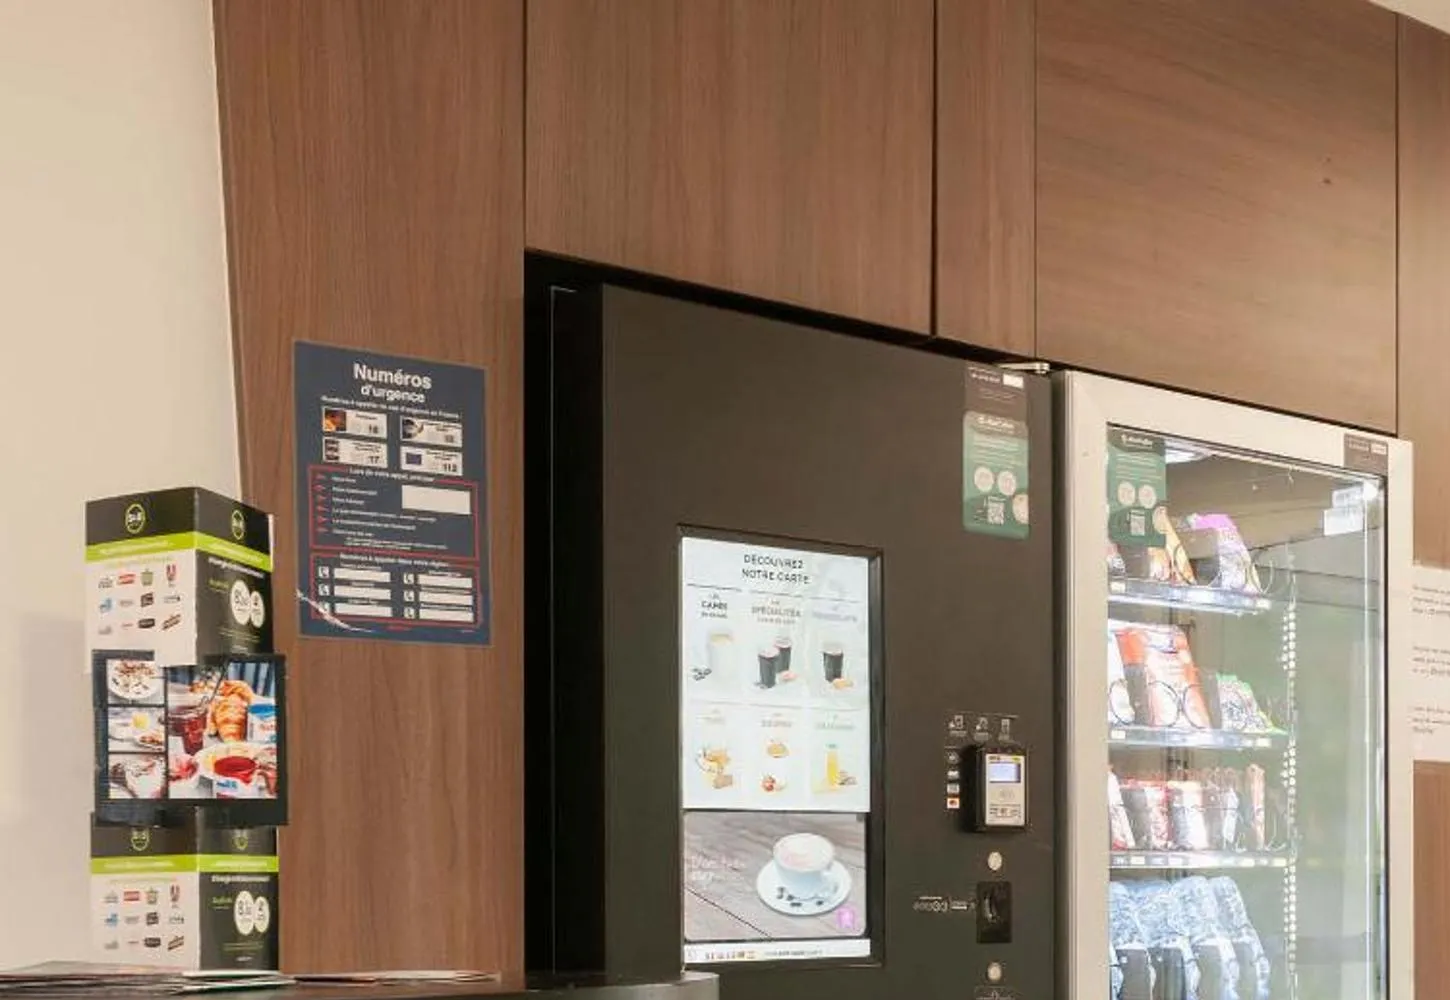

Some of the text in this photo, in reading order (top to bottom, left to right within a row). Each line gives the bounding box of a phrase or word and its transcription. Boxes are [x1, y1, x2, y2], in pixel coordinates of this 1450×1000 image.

[353, 362, 432, 390] Numéros
[360, 384, 426, 403] d'urgence
[741, 568, 811, 585] NOTRE CARTE
